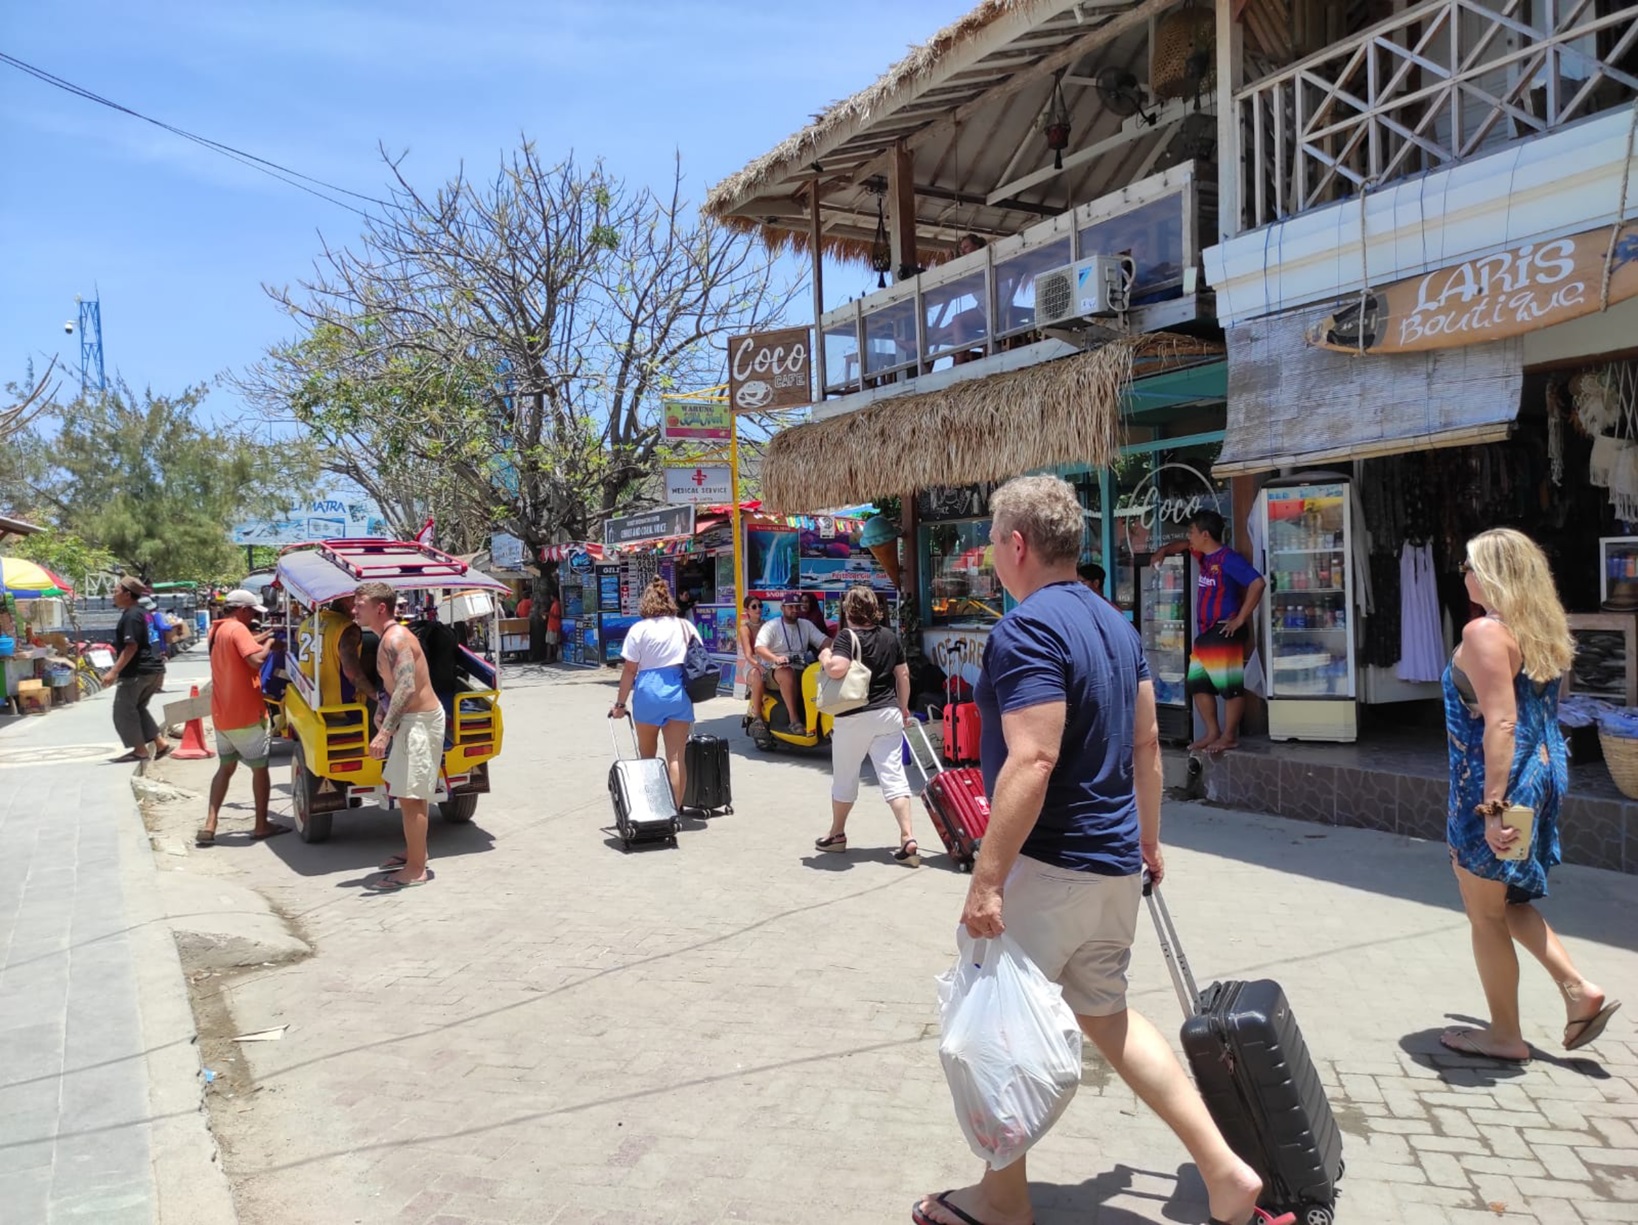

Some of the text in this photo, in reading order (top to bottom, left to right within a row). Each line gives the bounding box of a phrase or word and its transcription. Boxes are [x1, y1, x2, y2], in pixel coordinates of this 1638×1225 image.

[1400, 282, 1584, 346] Boutique
[733, 337, 807, 381] Coco
[299, 632, 323, 664] 24
[958, 637, 985, 669] CRE
